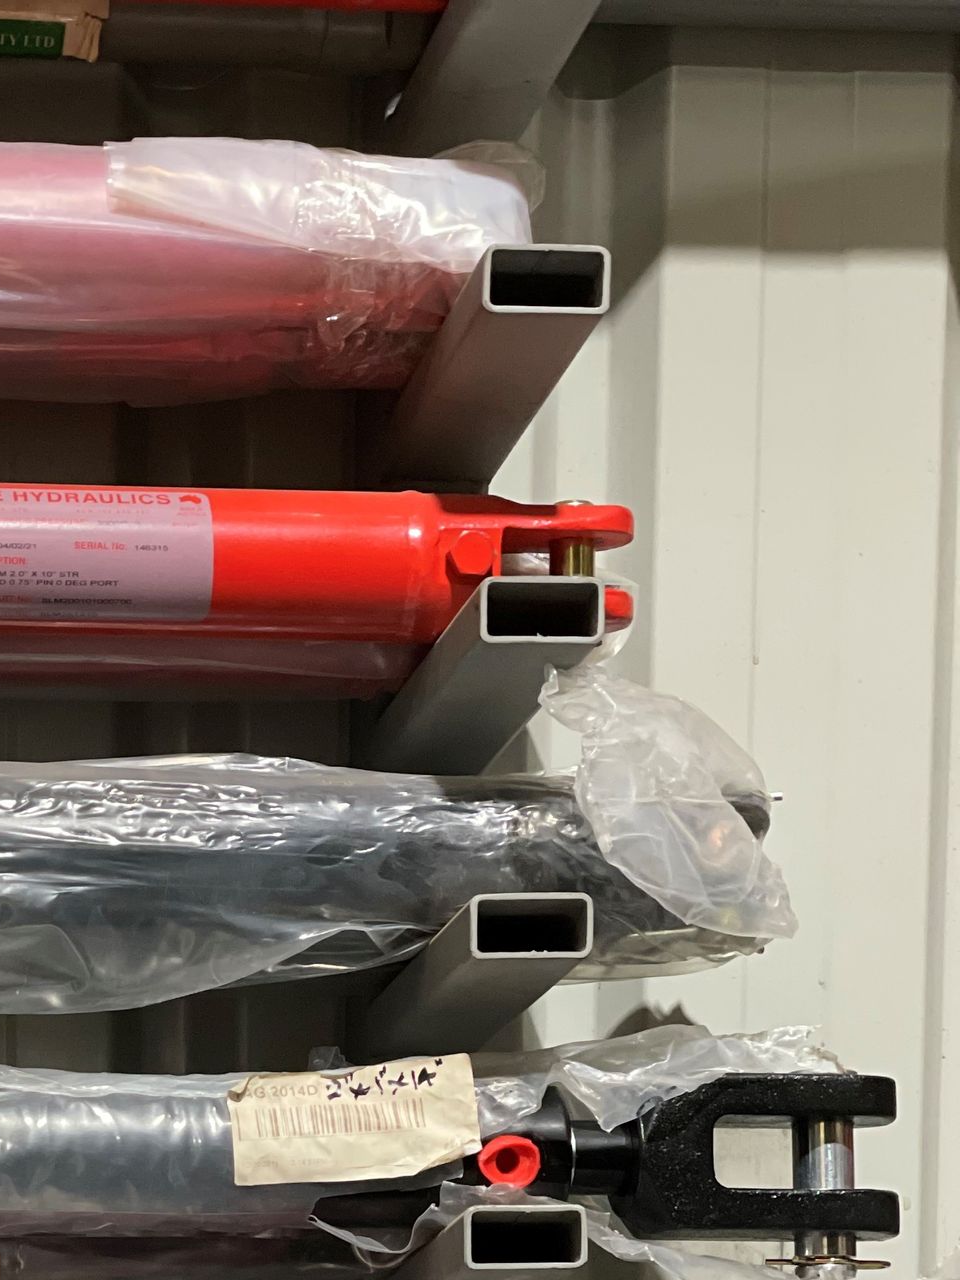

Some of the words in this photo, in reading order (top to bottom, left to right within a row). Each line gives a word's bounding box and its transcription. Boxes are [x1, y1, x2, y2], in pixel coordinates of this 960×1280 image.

[23, 34, 55, 49] LTD
[12, 490, 171, 506] HYDRAULICS
[74, 541, 109, 551] SERIAL
[244, 1086, 266, 1100] AG
[271, 1084, 319, 1098] 2014D
